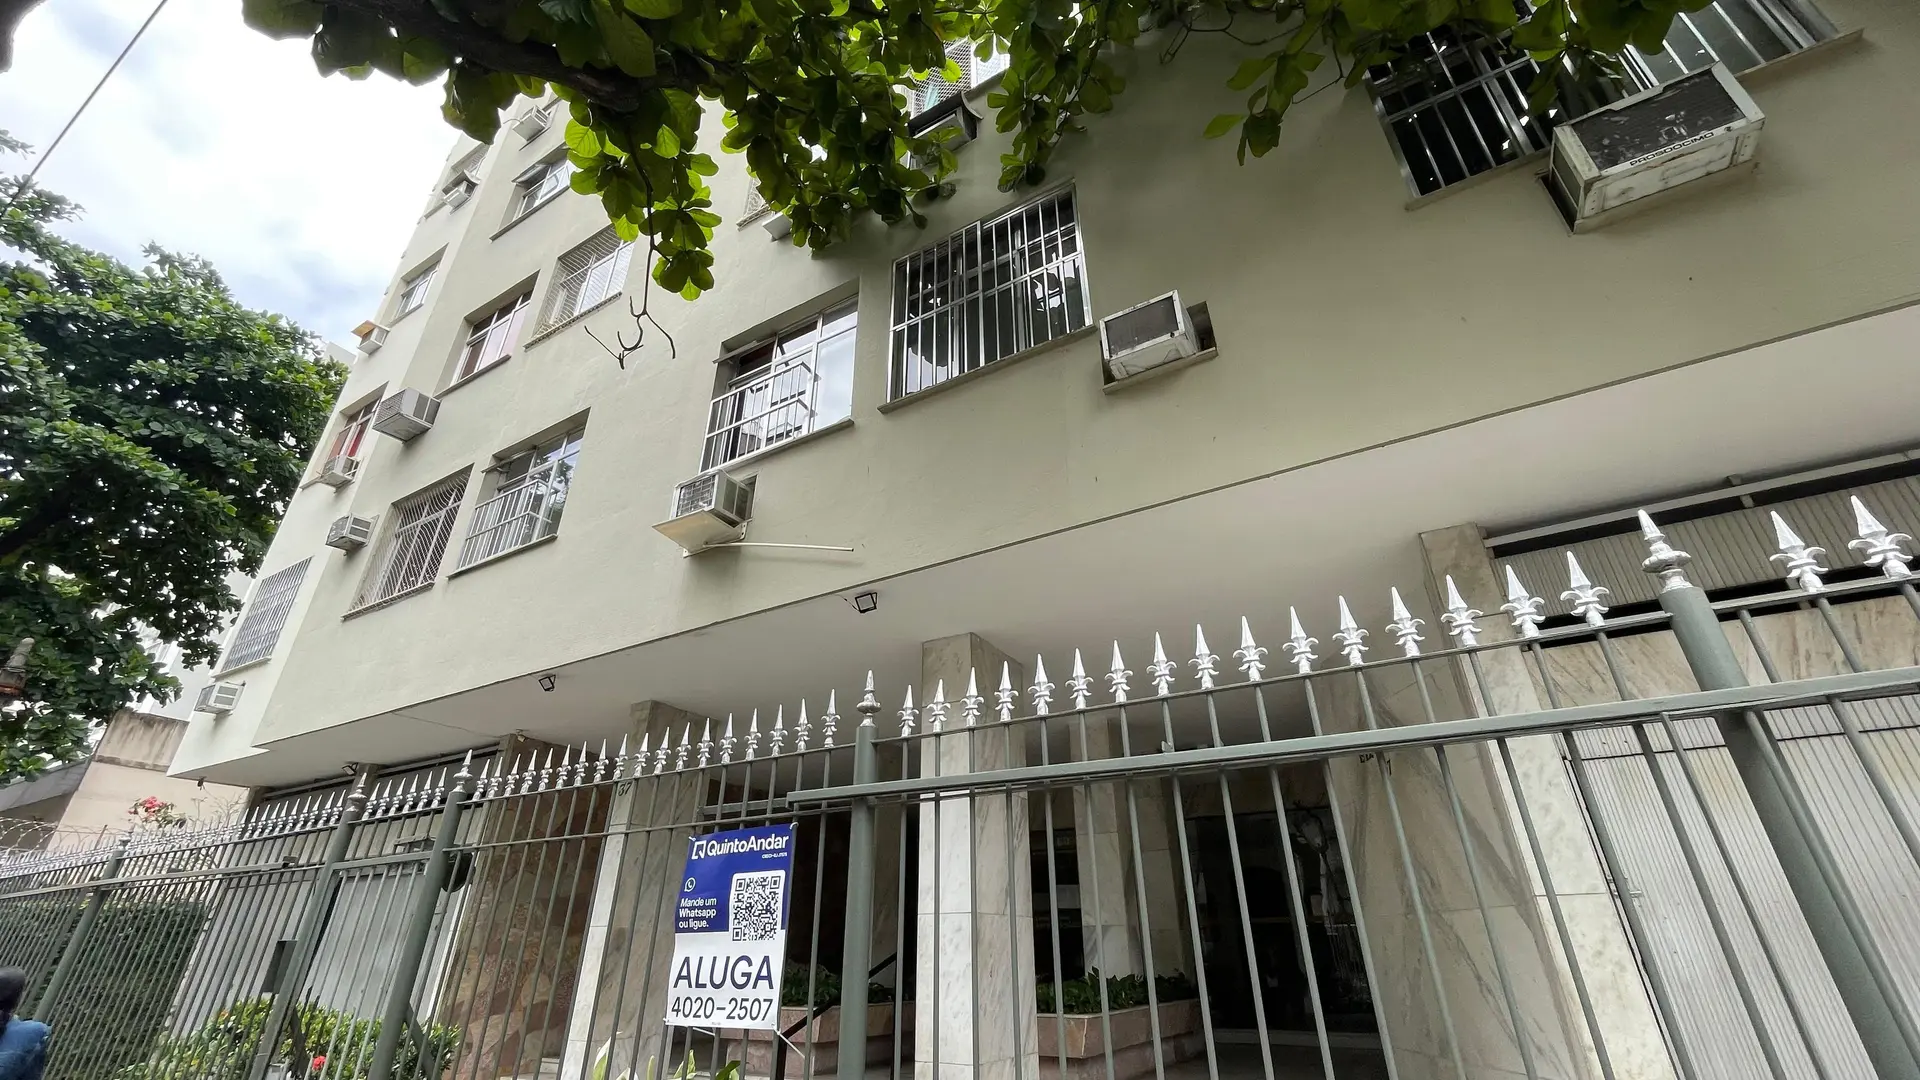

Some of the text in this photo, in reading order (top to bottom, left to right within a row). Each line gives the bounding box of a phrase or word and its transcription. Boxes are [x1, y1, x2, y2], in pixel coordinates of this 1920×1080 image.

[1629, 132, 1715, 166] PROSDOCIMO
[707, 834, 789, 856] QuintoAndar
[679, 908, 717, 918] Whatsapp
[680, 897, 717, 907] Mande um
[678, 919, 709, 930] ou ligue.
[673, 955, 774, 989] ALUGA
[671, 996, 773, 1021] 4020-2507
